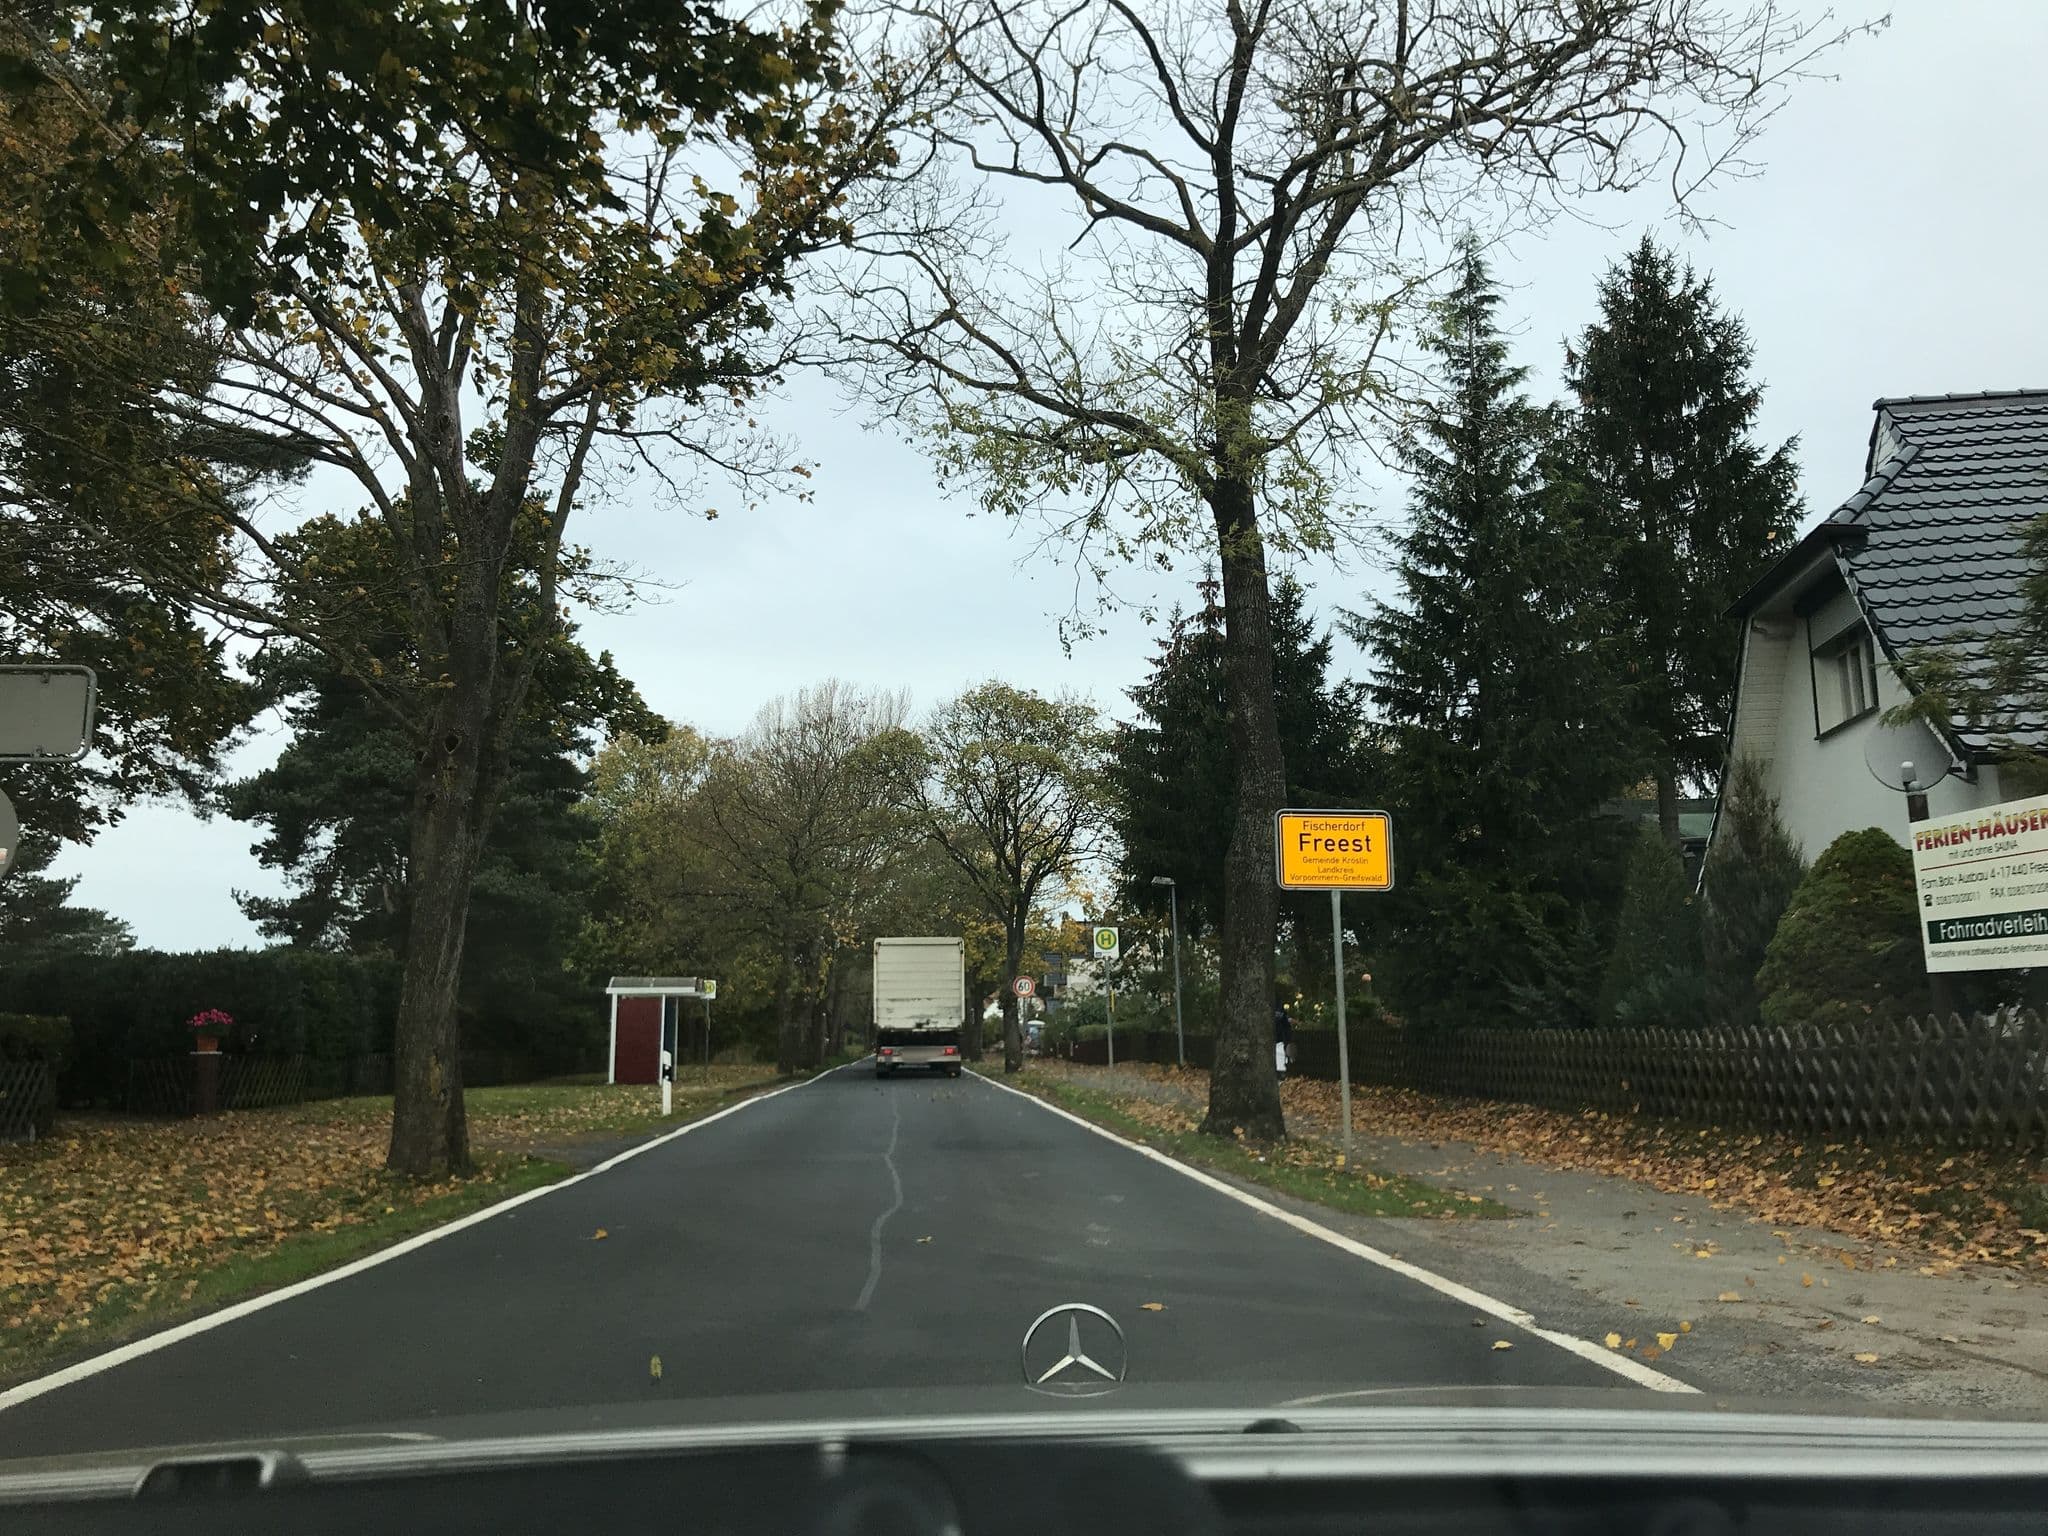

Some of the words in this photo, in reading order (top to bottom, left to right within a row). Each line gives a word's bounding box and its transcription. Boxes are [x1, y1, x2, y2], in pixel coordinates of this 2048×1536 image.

[1303, 821, 1365, 832] Fischerdorf
[1299, 833, 1371, 852] Freest
[1303, 856, 1339, 865] Gemeinde
[1318, 866, 1354, 874] Landkreis
[1290, 874, 1383, 883] Vorpommern-Greifswald
[1940, 912, 2048, 940] Fahrradverleih
[1101, 933, 1111, 945] H
[1018, 981, 1030, 992] 60
